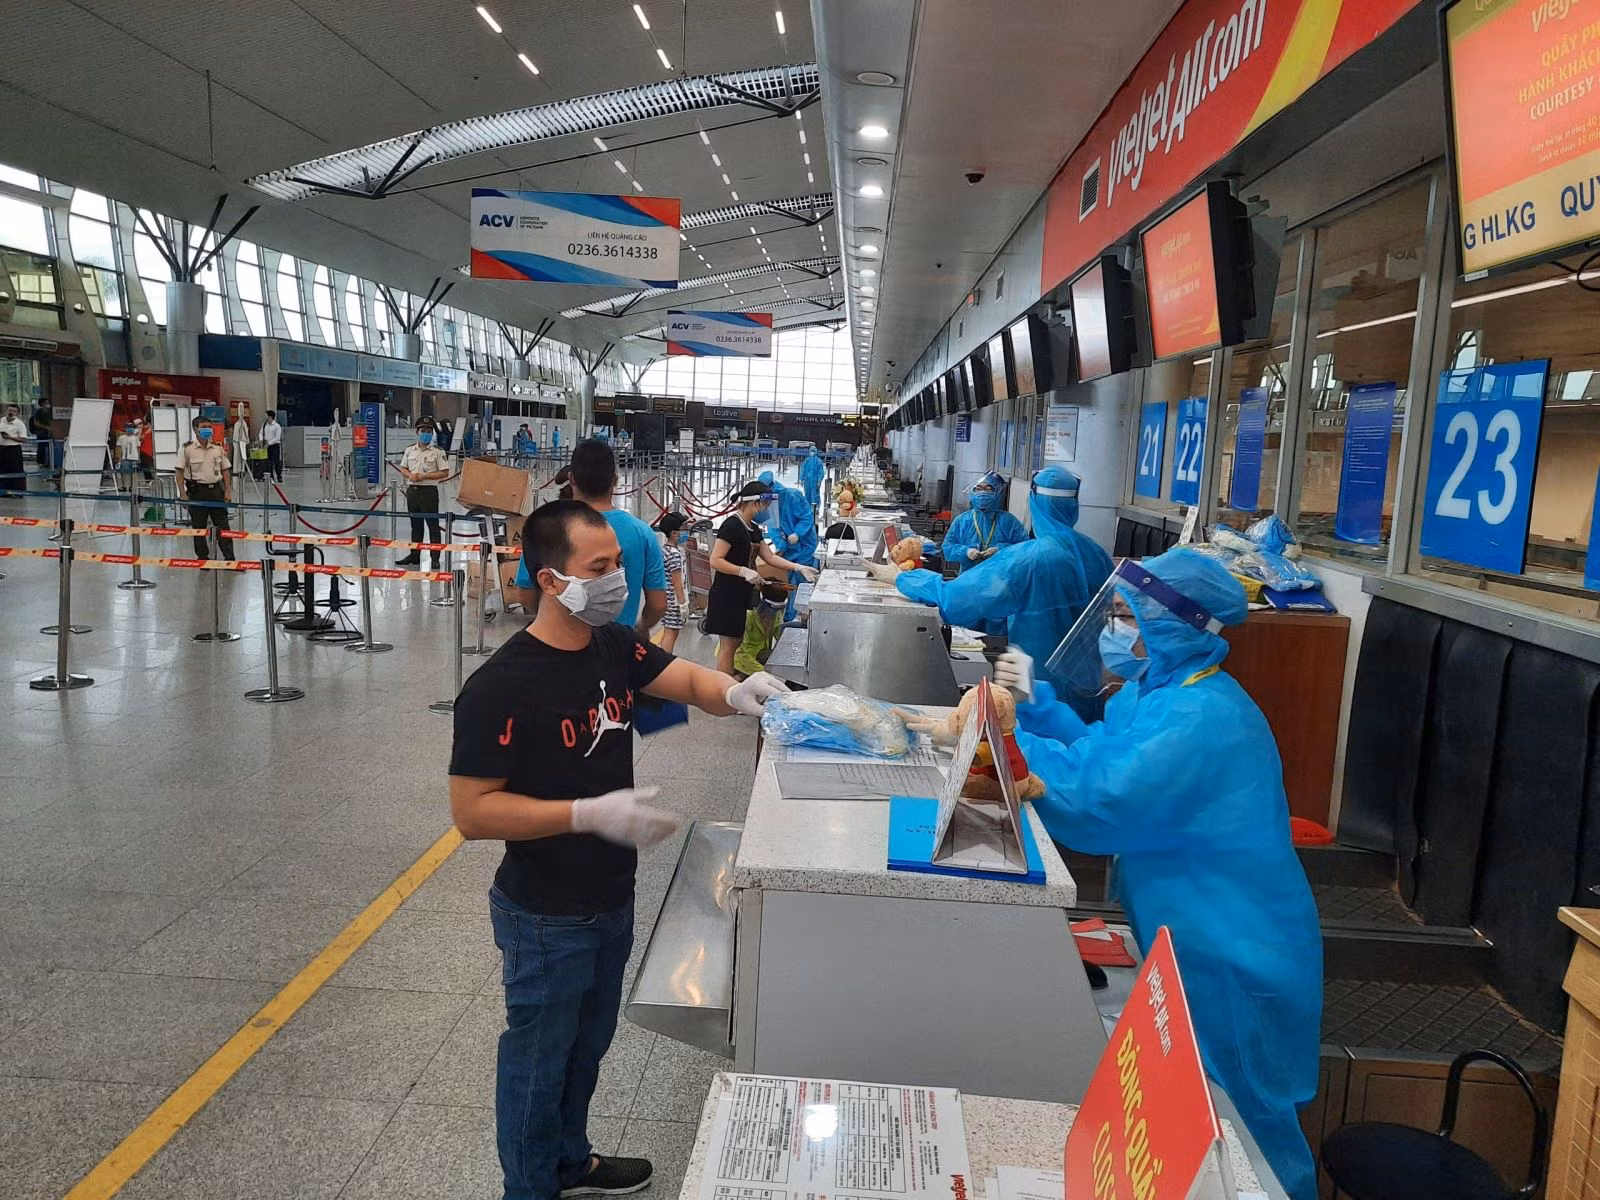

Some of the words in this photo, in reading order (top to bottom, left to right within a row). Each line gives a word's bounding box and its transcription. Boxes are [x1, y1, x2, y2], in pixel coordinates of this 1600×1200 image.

[1519, 72, 1555, 104] HÀNH
[1530, 75, 1595, 121] COURTESY
[479, 214, 515, 228] ACV
[601, 232, 610, 240] HỆ
[610, 232, 632, 241] QUẢNG
[633, 233, 647, 242] CÁO
[1481, 201, 1536, 245] HLKG
[567, 243, 658, 260] 0236.3614338
[671, 322, 689, 330] ACV
[715, 335, 762, 344] 0236.3614338
[1140, 422, 1160, 478] 21
[1176, 421, 1202, 483] 22
[1434, 409, 1522, 526] 23
